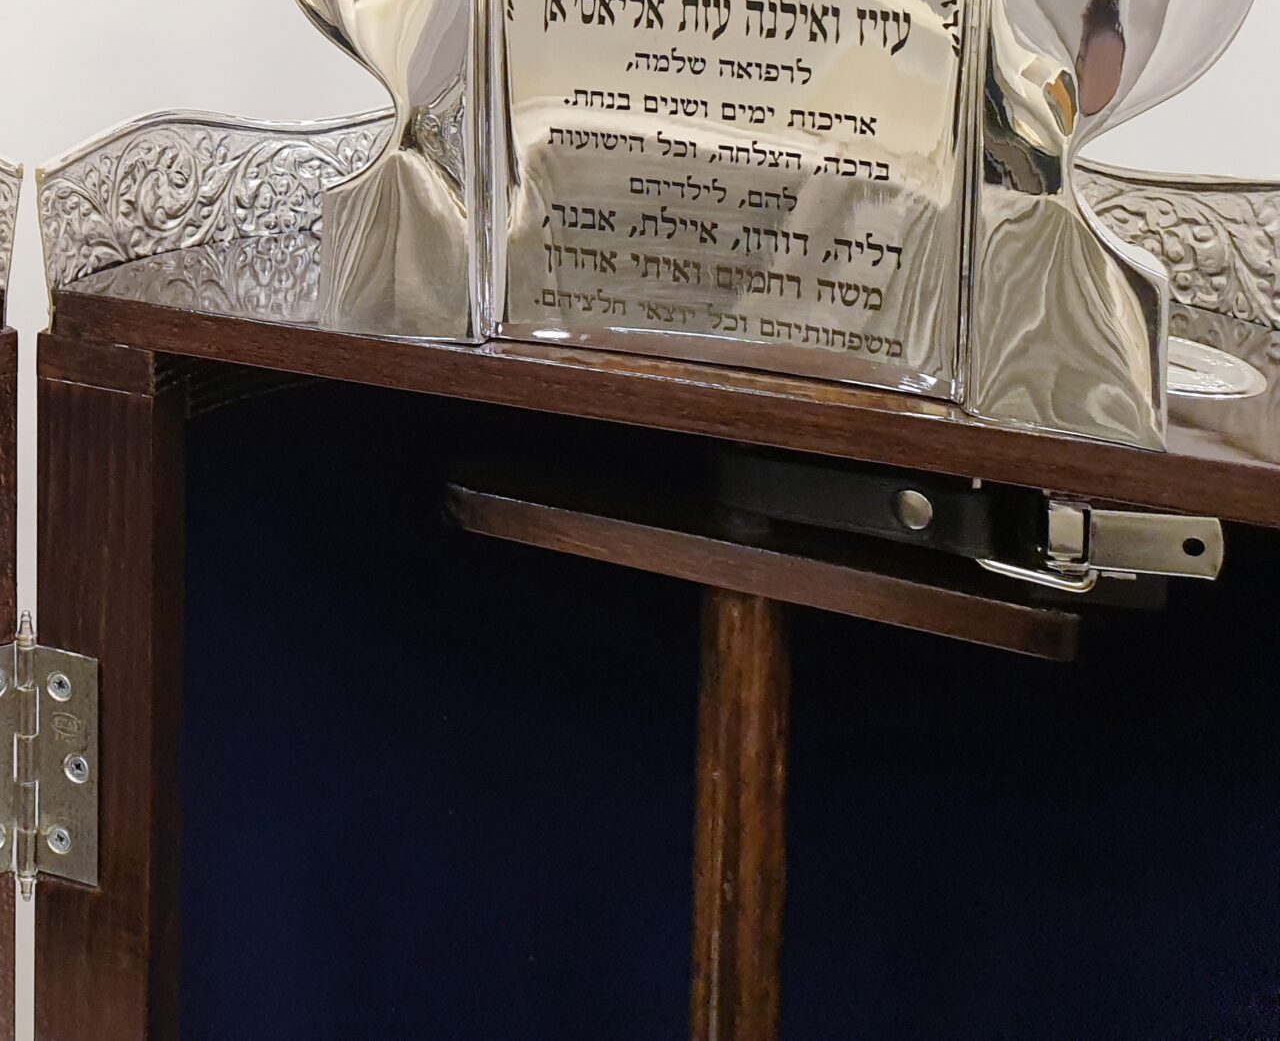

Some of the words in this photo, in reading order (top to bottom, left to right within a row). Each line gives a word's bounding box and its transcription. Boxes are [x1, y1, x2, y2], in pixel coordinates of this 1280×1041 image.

[856, 5, 912, 56] עזיז
[625, 47, 706, 76] שלמה,
[718, 56, 813, 86] לרפואה
[563, 88, 631, 111] בנחת.
[643, 94, 708, 118] ושנים
[721, 102, 775, 125] ימים
[787, 108, 877, 137] אריכות
[547, 126, 646, 153] הישועות
[657, 129, 698, 159] וכל
[708, 138, 802, 171] הצלחה,
[813, 153, 890, 182] ברכה,
[629, 174, 728, 204] לילדיהם
[738, 182, 798, 213] להם,
[541, 202, 616, 233] אבנר,
[628, 206, 718, 244] איילת,
[731, 221, 809, 256] דורון,
[822, 234, 904, 271] דליה,
[544, 242, 619, 274] אהרון
[631, 253, 702, 284] ואיתי
[716, 264, 802, 299] רחמים
[817, 276, 883, 311] משה
[533, 288, 627, 316] חלציהם.
[707, 302, 748, 334] וכל
[760, 316, 904, 358] משפחותיהם
